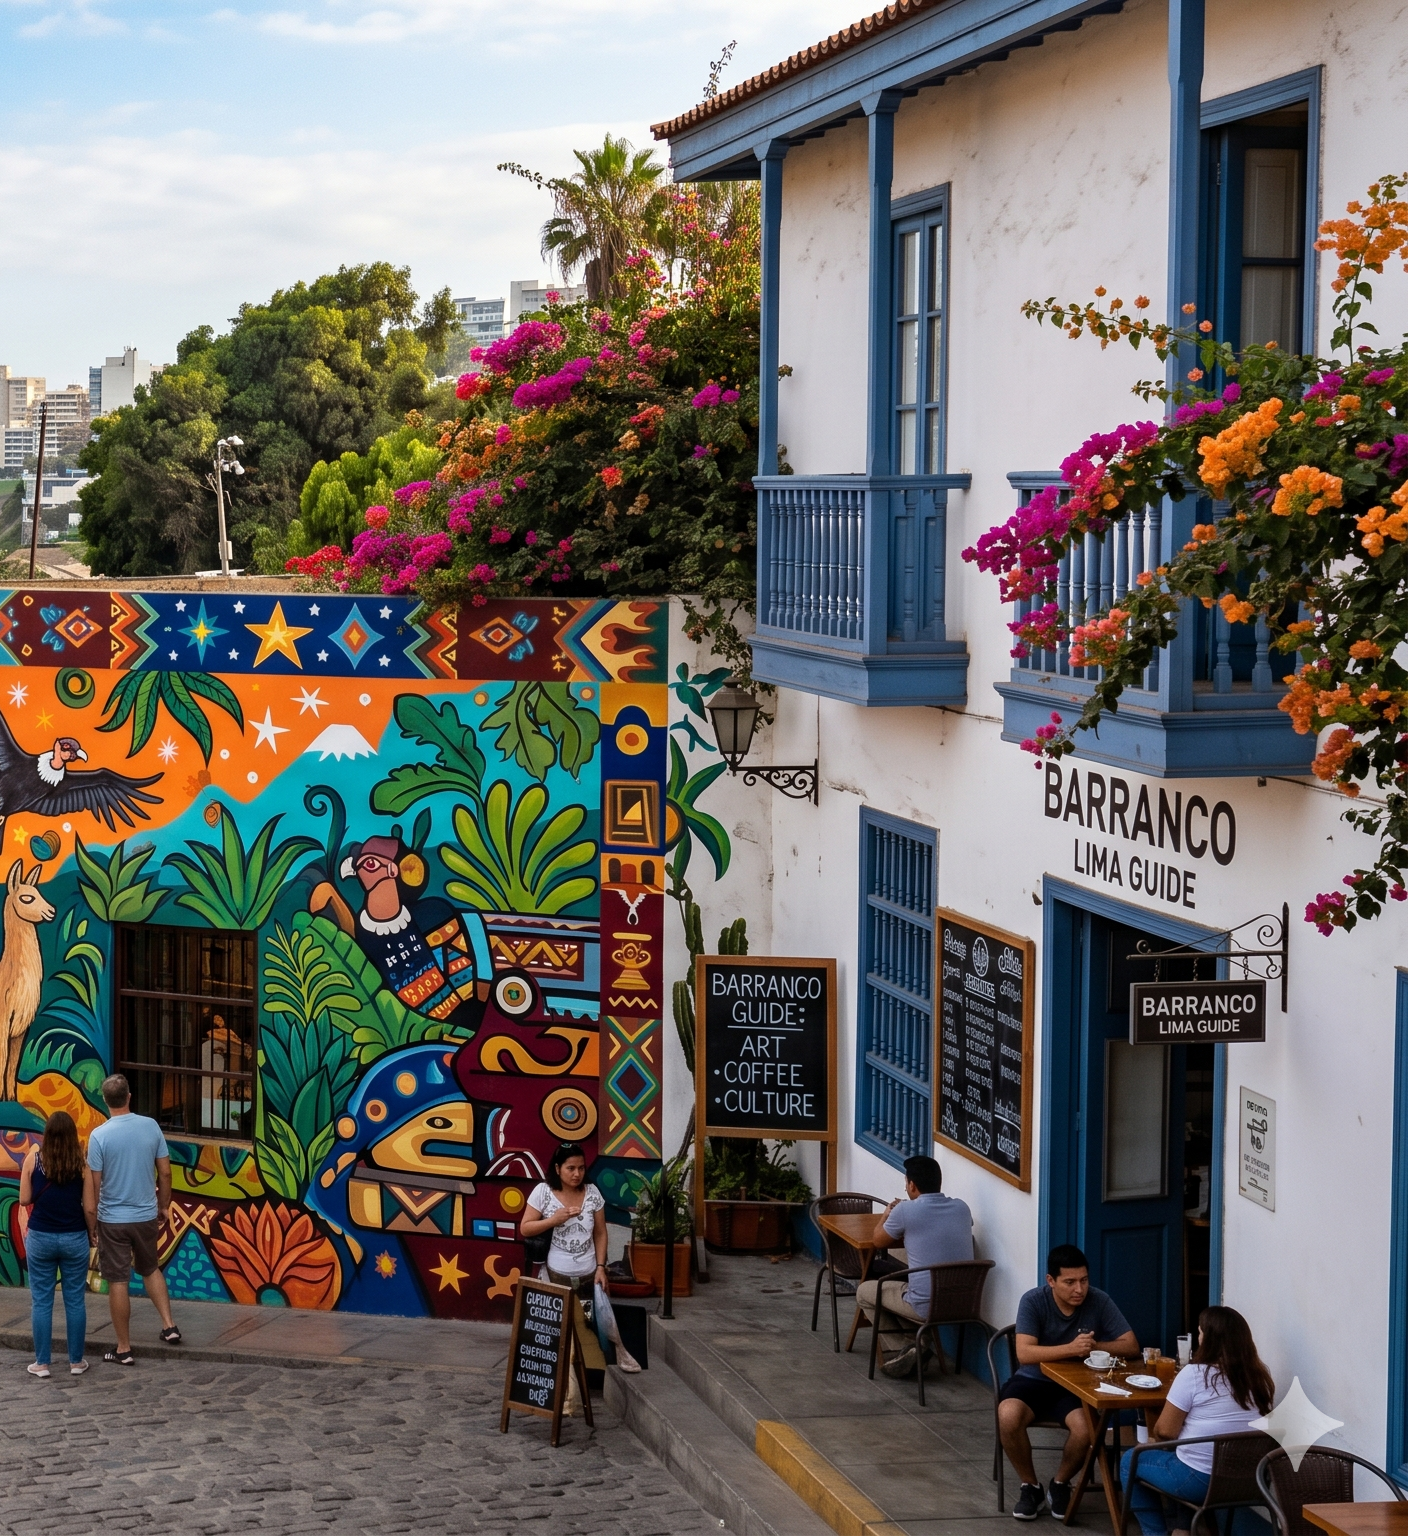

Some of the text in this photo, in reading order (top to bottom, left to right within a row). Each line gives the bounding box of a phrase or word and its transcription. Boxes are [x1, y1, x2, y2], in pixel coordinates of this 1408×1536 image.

[1045, 760, 1238, 867] BARRANCO
[1073, 838, 1196, 910] LIMA GUIDE
[712, 972, 822, 999] BARRANCO
[732, 1000, 806, 1026] GUIDE:
[1142, 993, 1257, 1017] BARRANCO
[1159, 1018, 1240, 1035] LIMA GUIDE
[739, 1035, 787, 1059] ART
[723, 1060, 805, 1087] COFFEE
[723, 1089, 816, 1117] CULTURE
